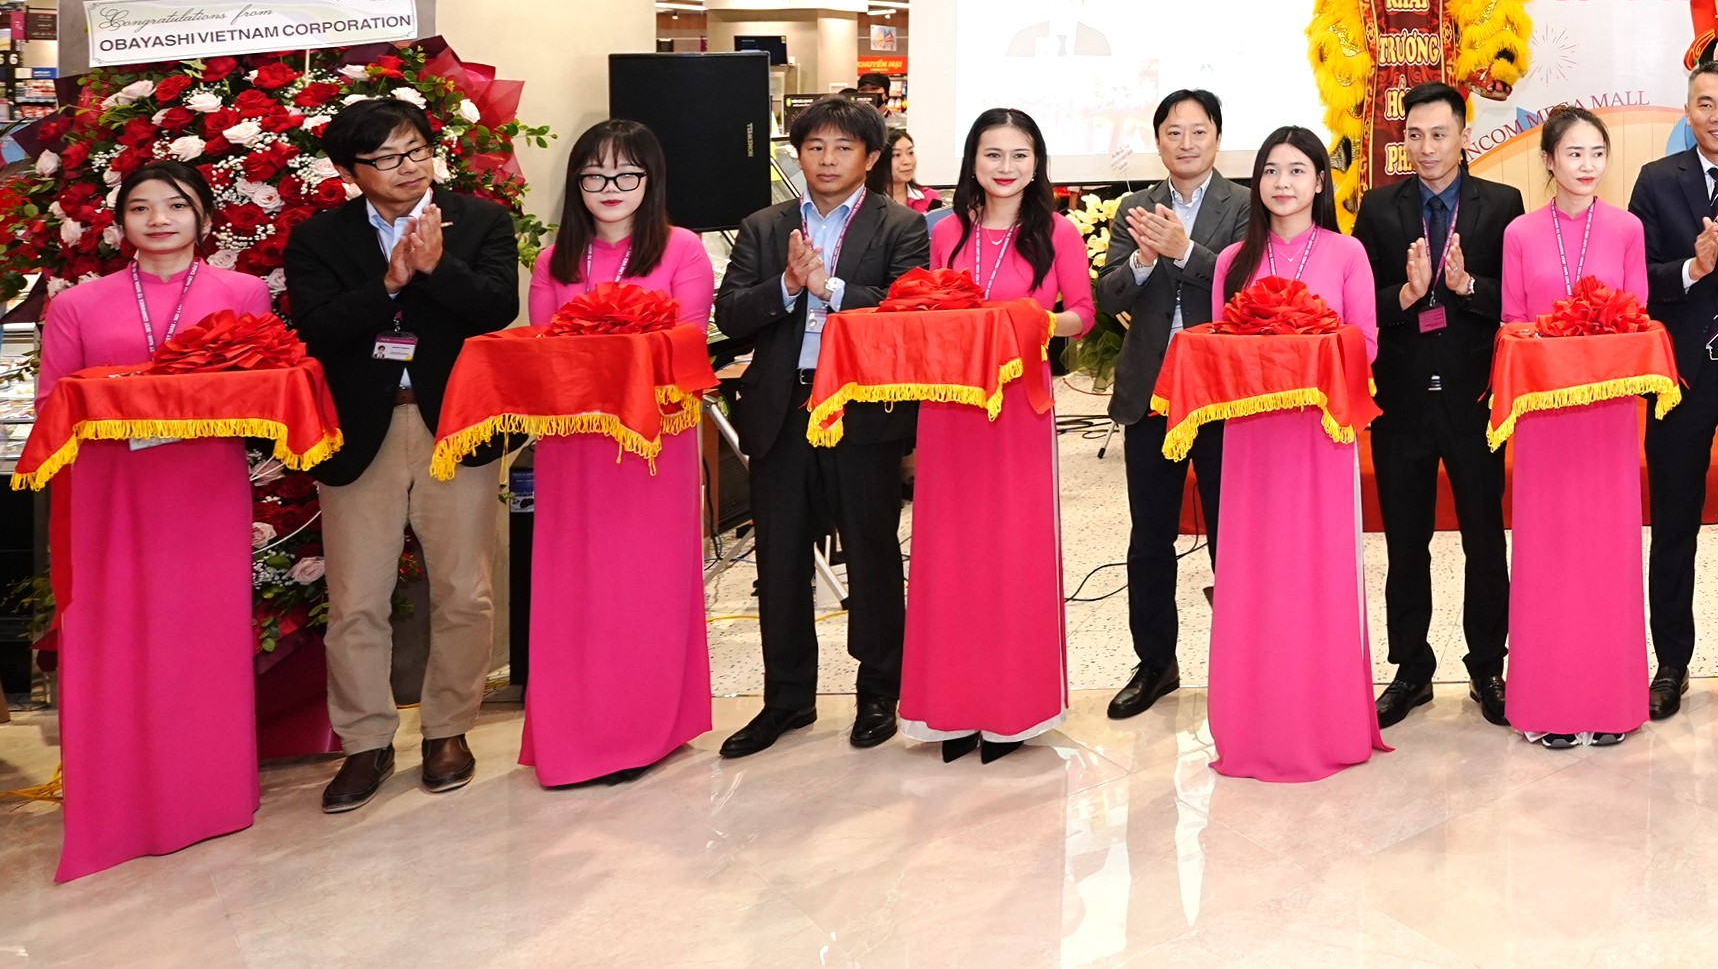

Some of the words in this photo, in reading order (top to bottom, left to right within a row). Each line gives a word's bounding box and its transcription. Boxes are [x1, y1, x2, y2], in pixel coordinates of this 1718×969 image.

[98, 6, 227, 35] Congratulations
[230, 4, 272, 26] from
[99, 32, 196, 52] OBAYASHI
[197, 26, 279, 44] VIETNAM
[281, 14, 412, 36] CORPORATION
[1378, 28, 1441, 67] TRƯƠNG
[1590, 90, 1650, 108] MALL
